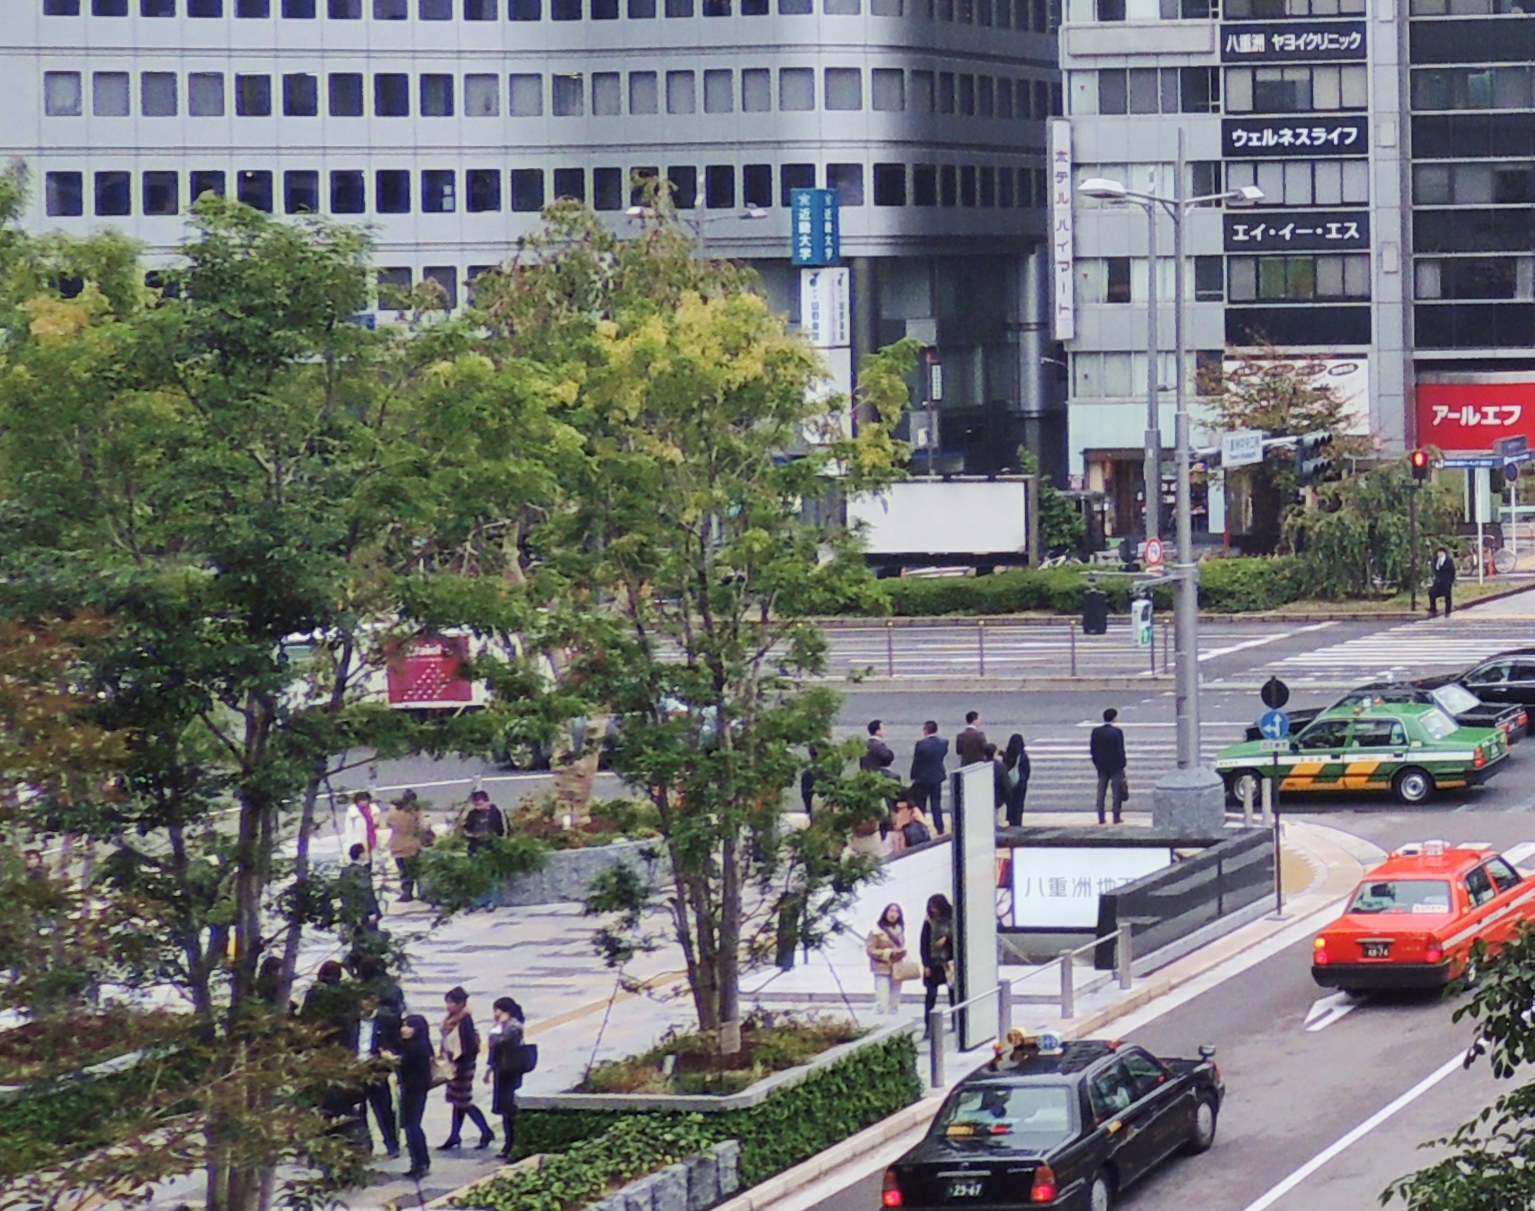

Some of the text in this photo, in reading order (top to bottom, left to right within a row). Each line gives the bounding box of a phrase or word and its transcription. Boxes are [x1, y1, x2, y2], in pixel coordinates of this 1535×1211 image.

[1271, 31, 1362, 52] ヤヨイクリニック
[1232, 126, 1358, 148] ウェルネスライフ
[1232, 222, 1361, 242] エイ・イー・エス
[1432, 405, 1522, 426] アールエフ
